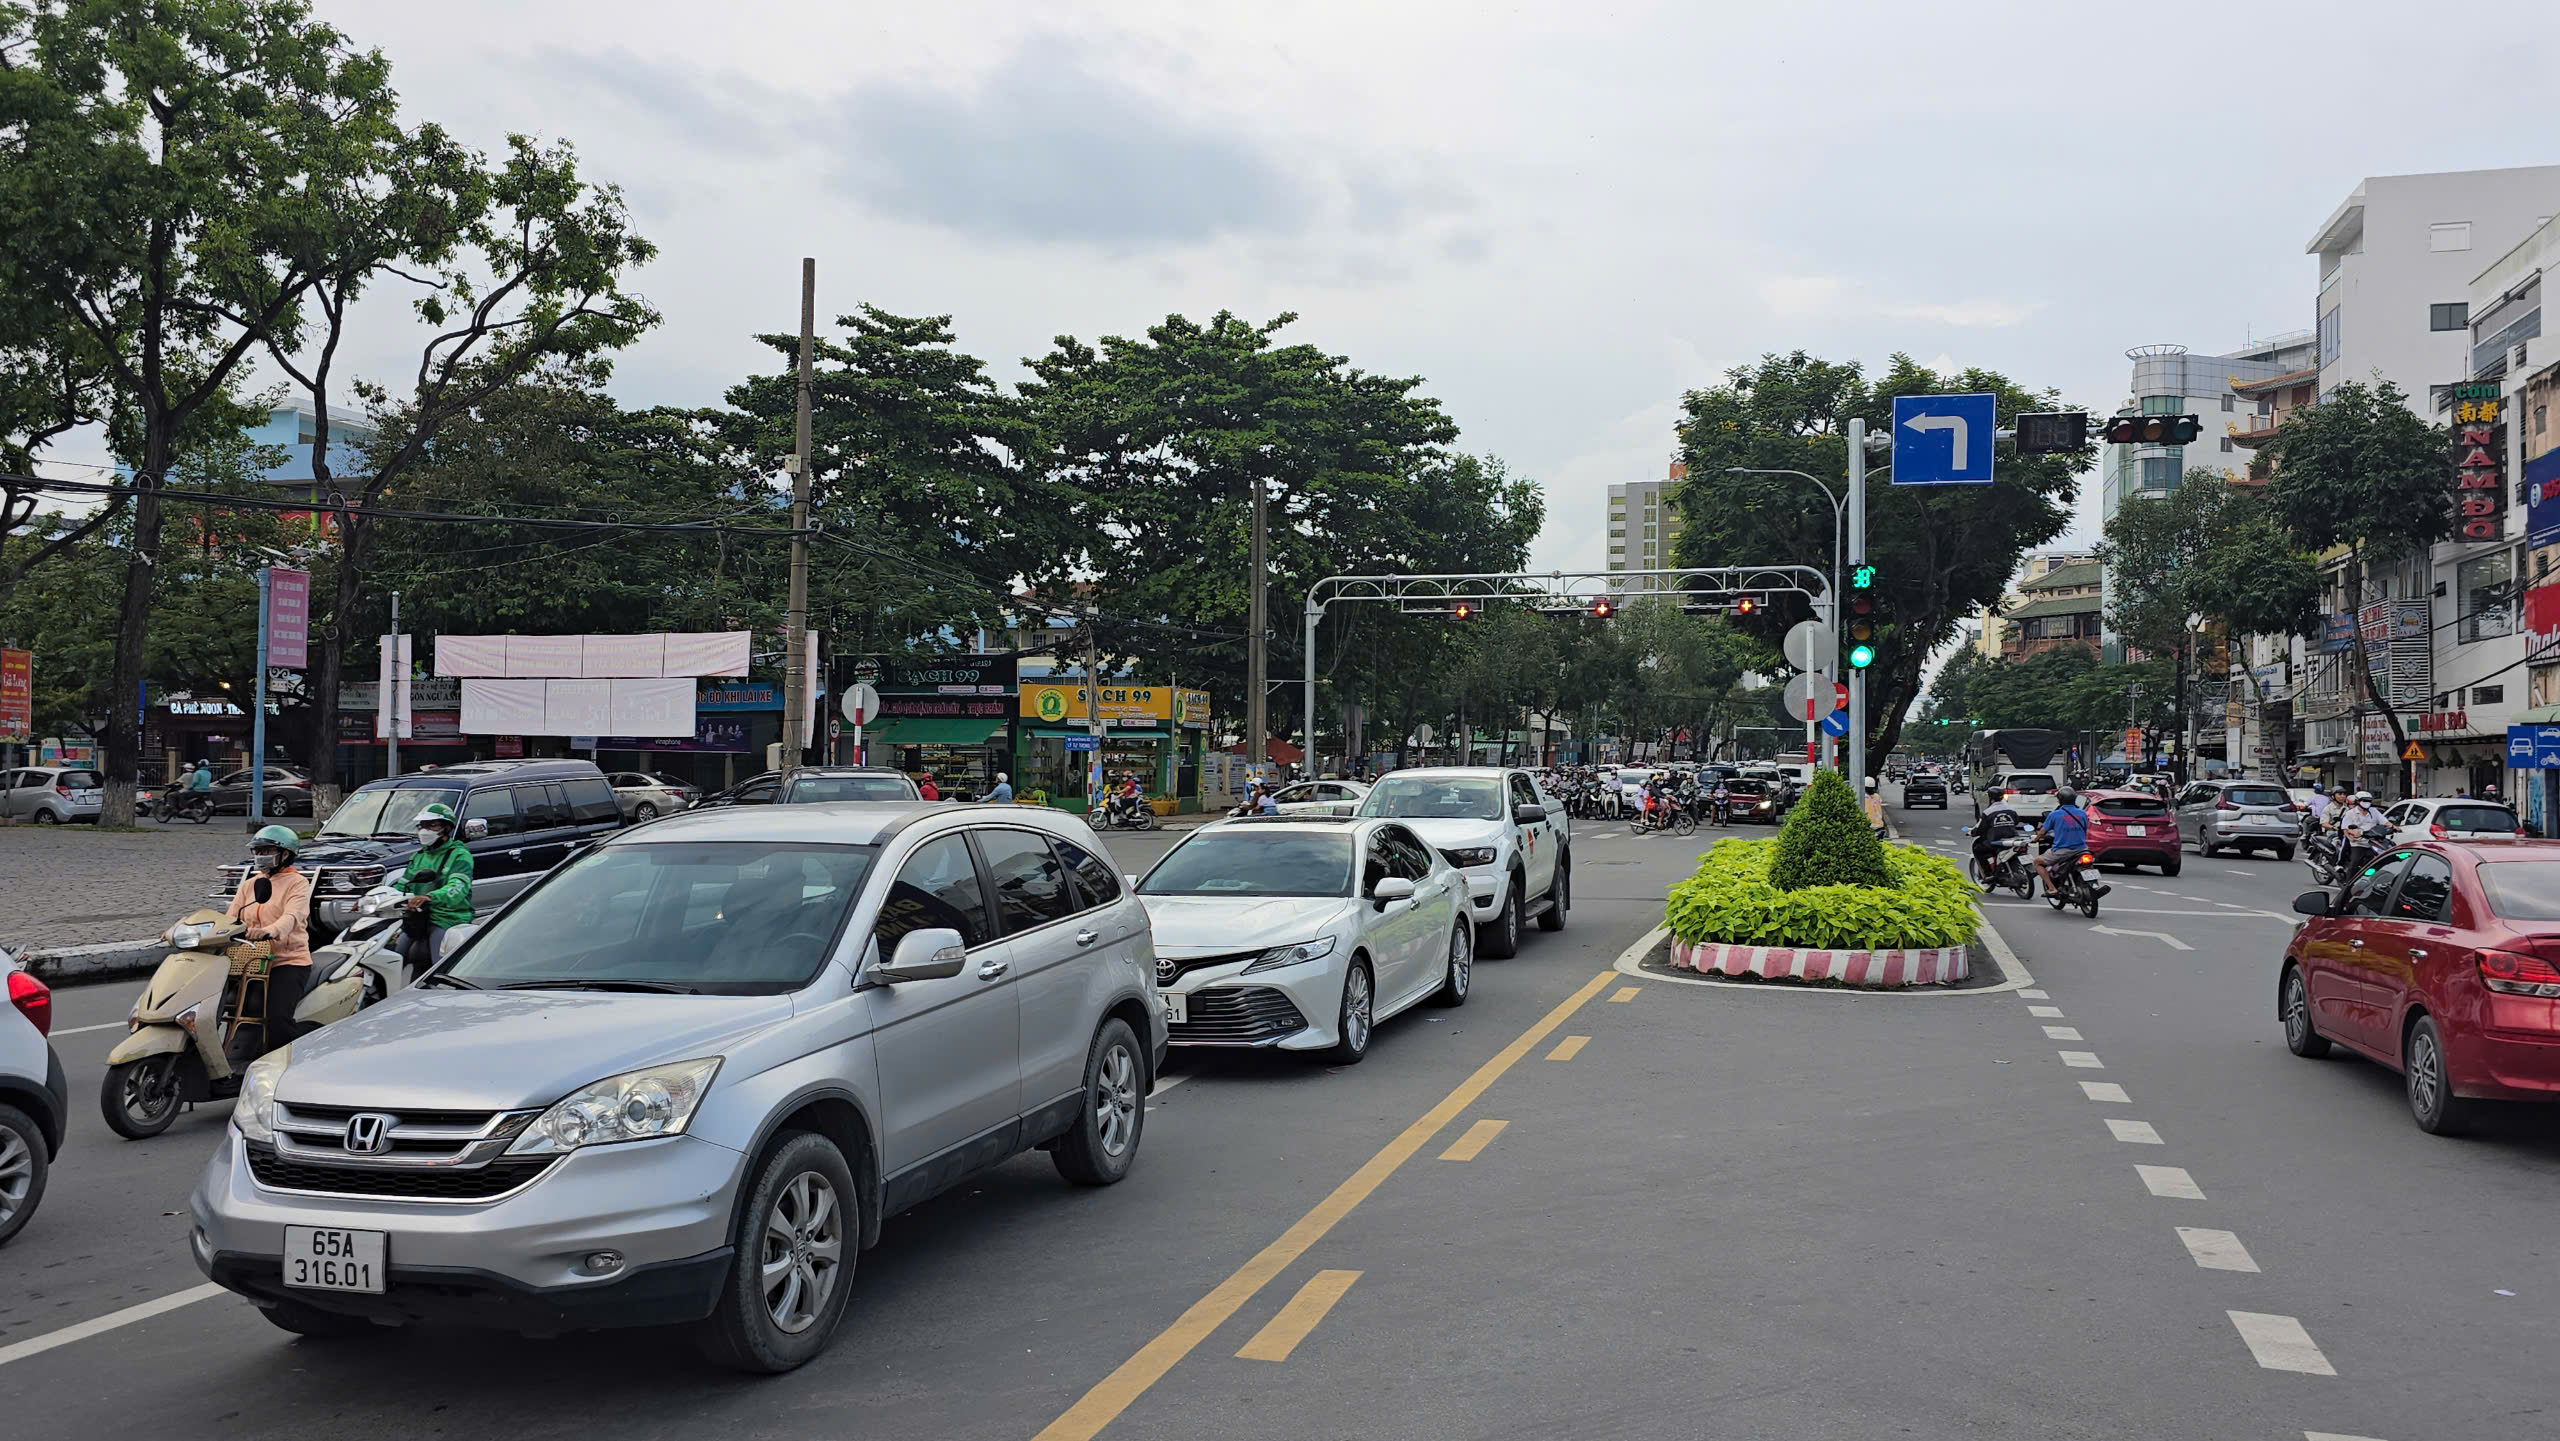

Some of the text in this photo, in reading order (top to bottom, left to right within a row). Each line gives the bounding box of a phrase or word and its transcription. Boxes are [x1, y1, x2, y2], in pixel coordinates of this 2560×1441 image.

[2457, 430, 2498, 490] NAM
[956, 670, 980, 683] 99
[724, 690, 740, 702] KHI
[759, 690, 772, 701] XE
[1077, 688, 1152, 703] SCH 99
[201, 702, 222, 714] NGON
[312, 1230, 354, 1258] 65A
[294, 1258, 370, 1289] 316.01
